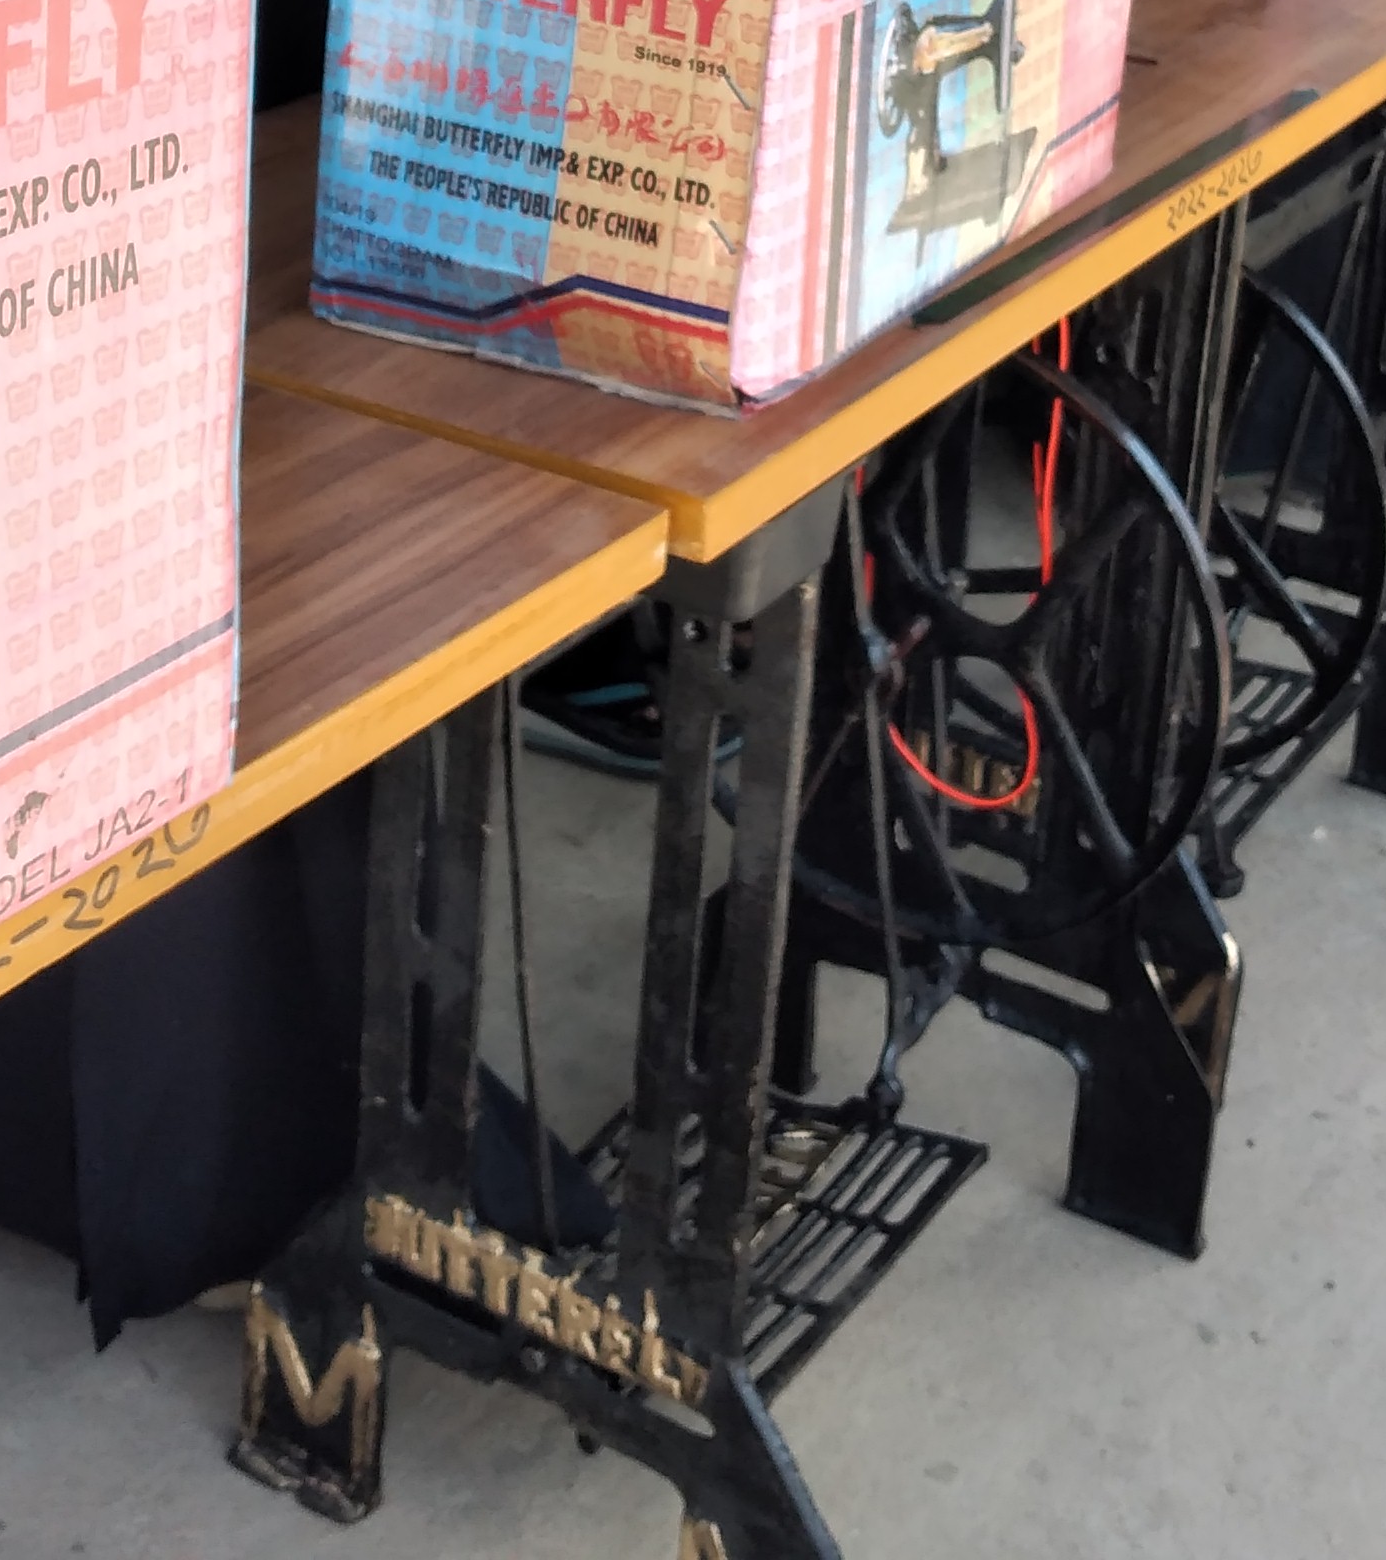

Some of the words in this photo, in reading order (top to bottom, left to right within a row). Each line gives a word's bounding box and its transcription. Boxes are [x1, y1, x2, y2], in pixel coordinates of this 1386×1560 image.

[635, 45, 681, 68] Since
[688, 58, 727, 77] 1919
[62, 158, 117, 214] CO.,
[130, 132, 189, 192] LTD.
[332, 91, 418, 136] SHANGHAI
[424, 116, 525, 162] BUTTERFLY
[587, 156, 624, 187] EXP.
[631, 166, 667, 202] CO.,
[675, 177, 715, 209] LTD.
[370, 149, 401, 181] THE
[404, 160, 483, 202] PEOPLE'S
[487, 181, 571, 226] REPUBLIC
[577, 204, 600, 231] OF
[604, 212, 659, 247] CHINA
[47, 242, 139, 317] CHINA
[85, 767, 193, 861] JA2-1
